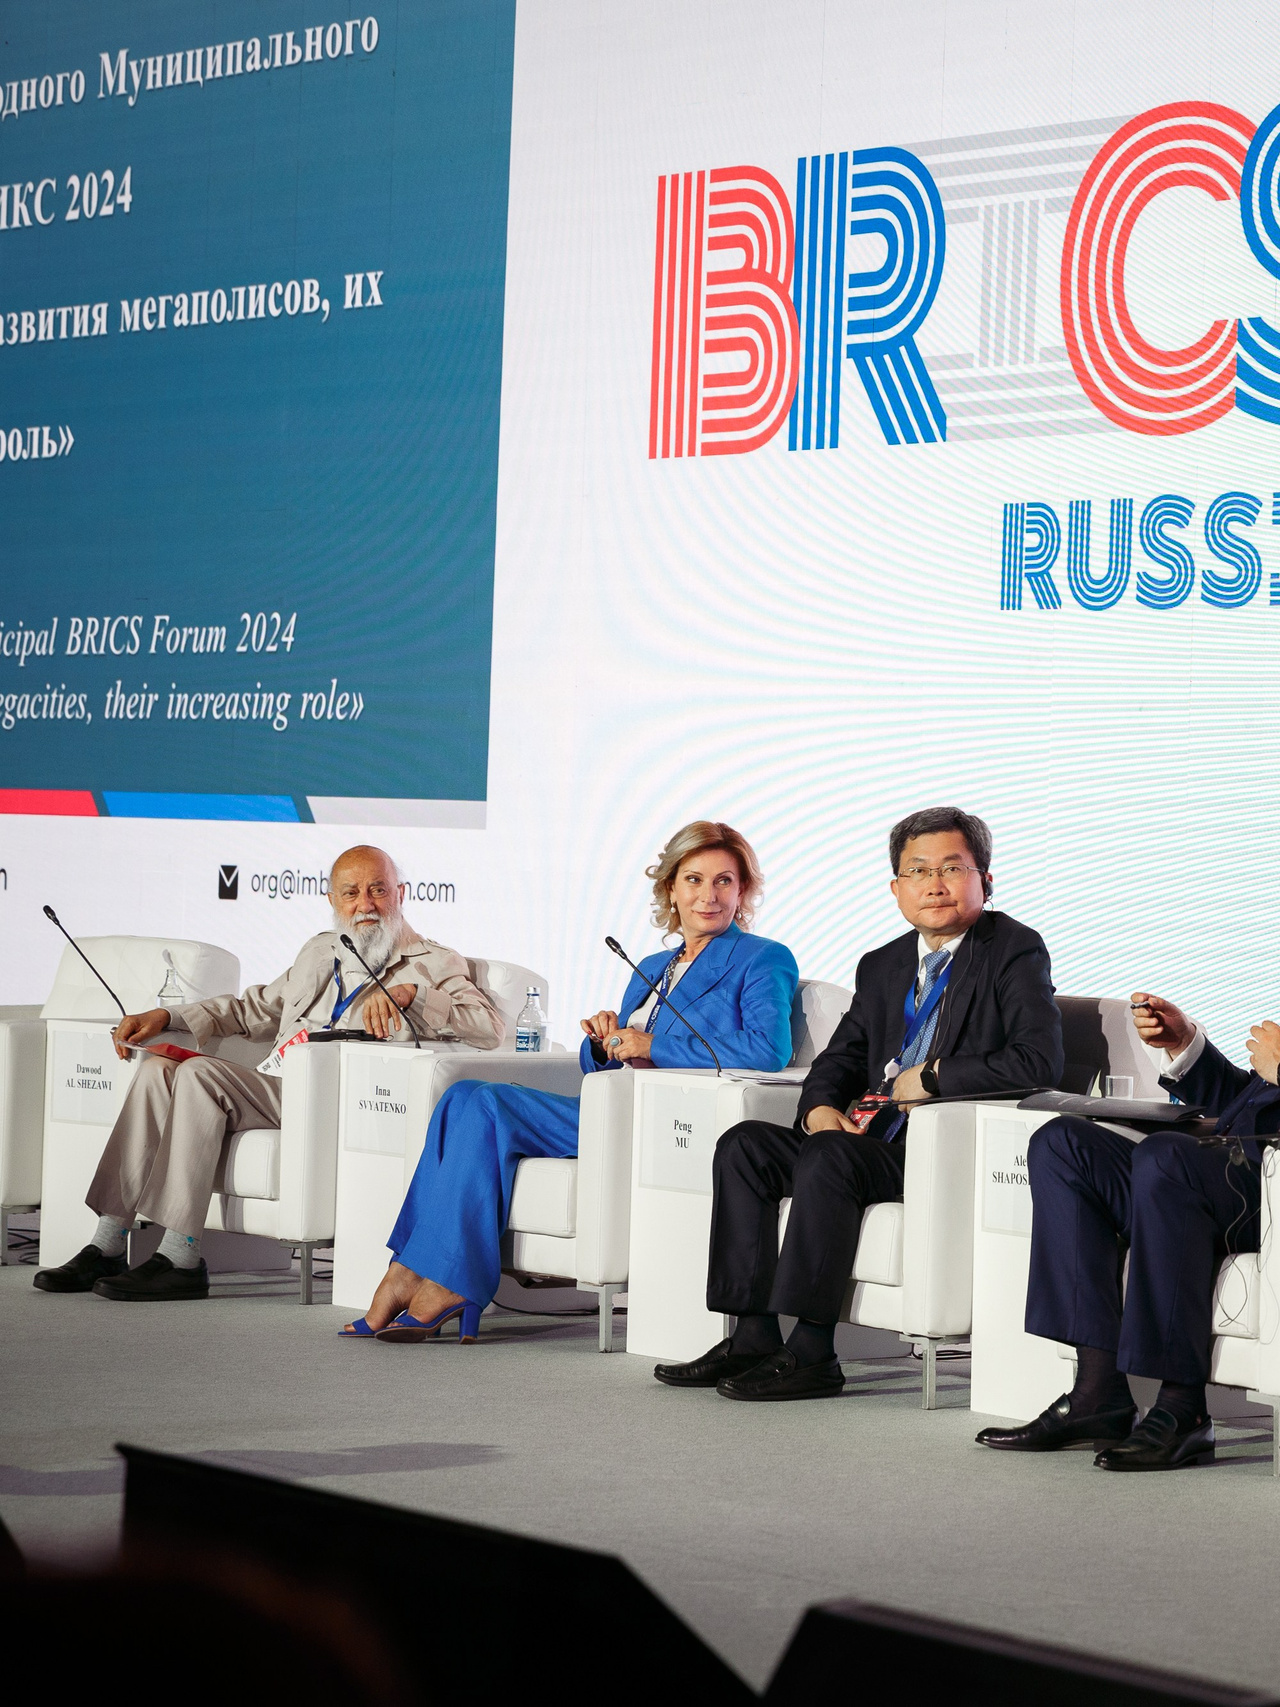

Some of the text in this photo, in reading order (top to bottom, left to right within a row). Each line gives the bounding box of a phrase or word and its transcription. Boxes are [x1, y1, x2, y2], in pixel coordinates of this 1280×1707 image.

[0, 15, 380, 121] дного Муниципального
[65, 165, 133, 221] 2024
[119, 277, 331, 333] мегаполисов,
[343, 270, 384, 309] их
[65, 614, 143, 656] BRICS
[149, 614, 227, 655] Forum
[235, 611, 297, 653] 2024
[104, 679, 159, 720] their
[166, 681, 292, 732] increasing
[300, 678, 365, 721] role»
[76, 1063, 102, 1075] Dawood
[65, 1078, 112, 1091] AL SHEZAWI
[375, 1085, 391, 1097] Inna
[358, 1099, 407, 1115] SVYATENKO
[673, 1119, 693, 1134] Peng
[675, 1136, 690, 1149] MU
[992, 1171, 1031, 1186] SHAPOS
